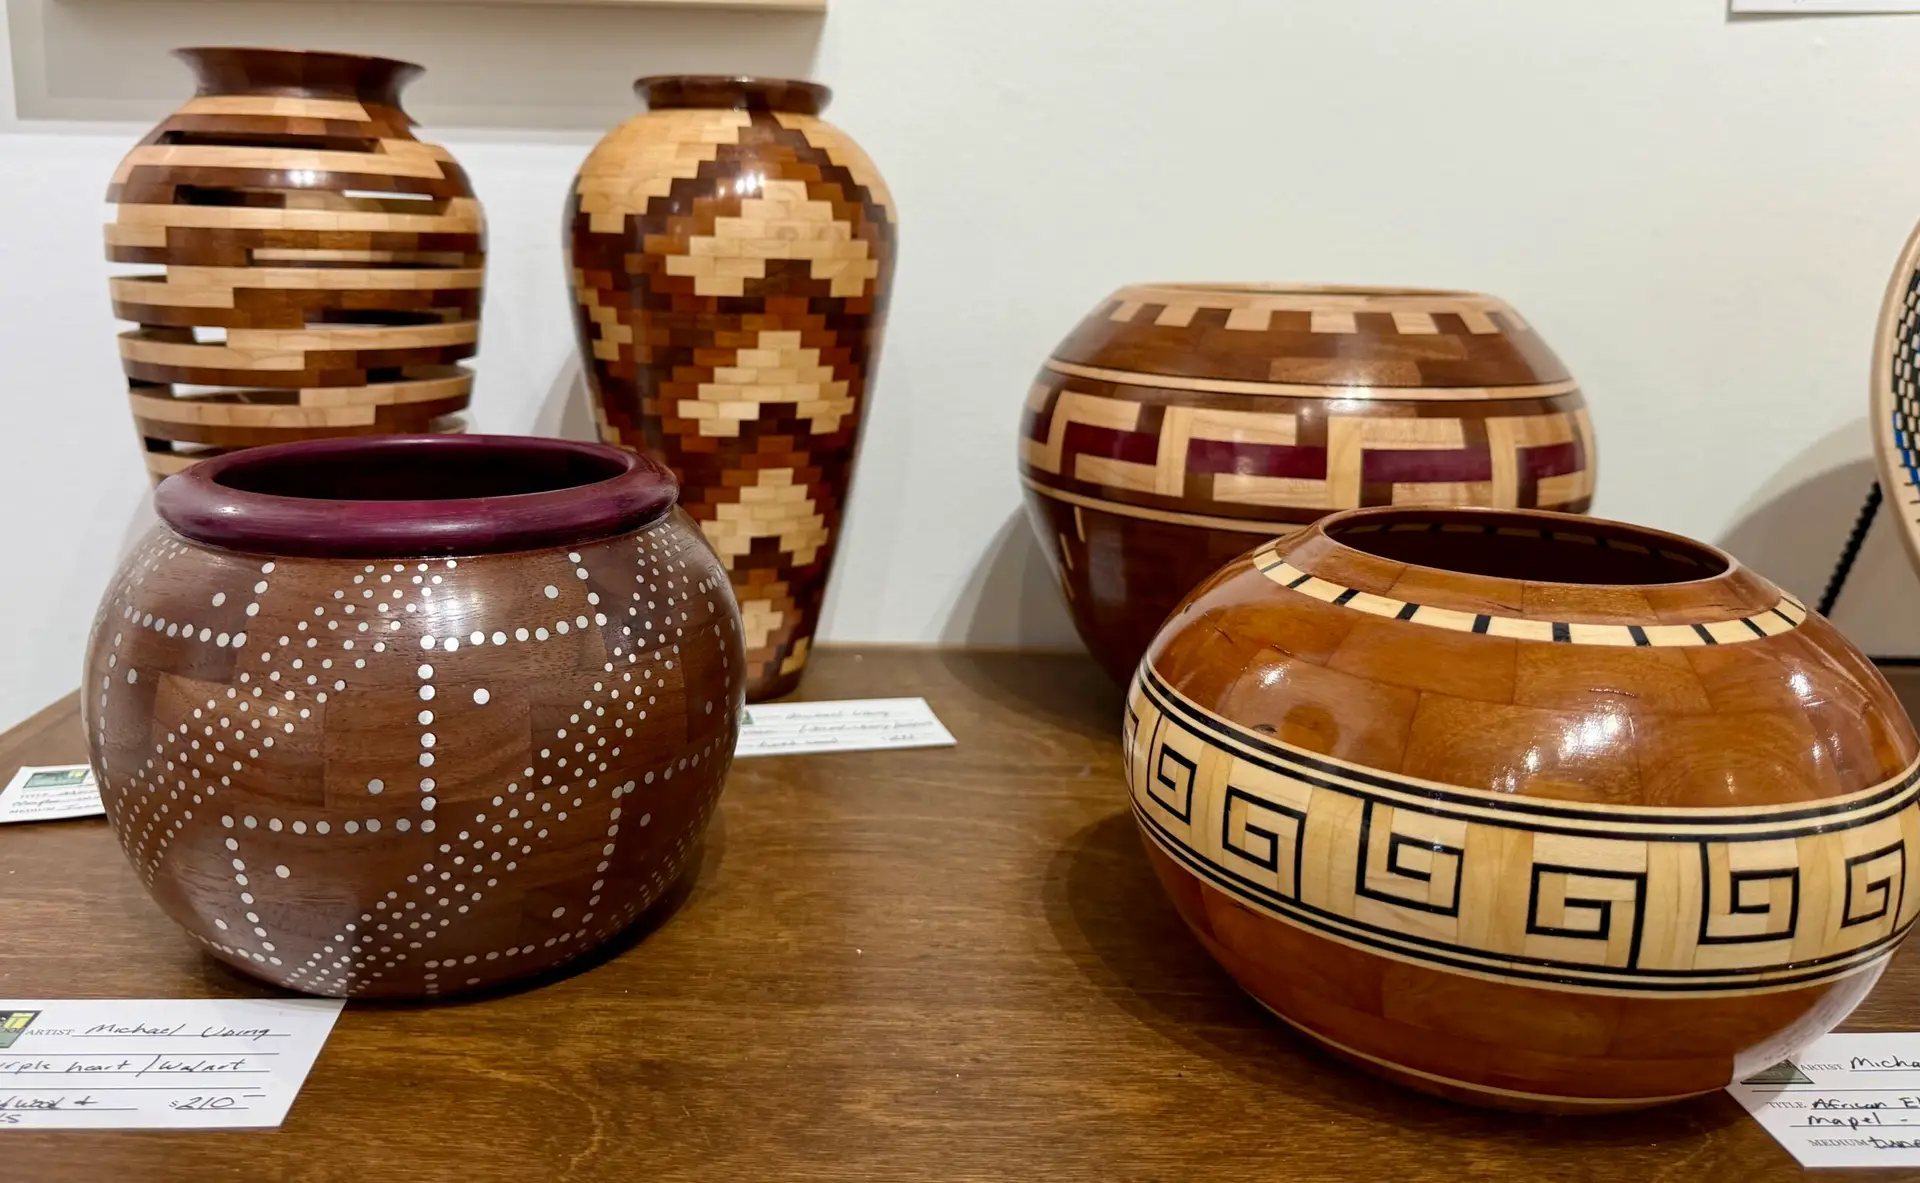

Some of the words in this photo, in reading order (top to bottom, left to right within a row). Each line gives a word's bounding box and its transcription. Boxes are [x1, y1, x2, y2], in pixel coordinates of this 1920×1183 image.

[85, 1023, 186, 1037] Michael
[65, 1061, 132, 1073] heart
[1812, 1098, 1887, 1109] African
[1807, 1138, 1869, 1147] MEDIUM
